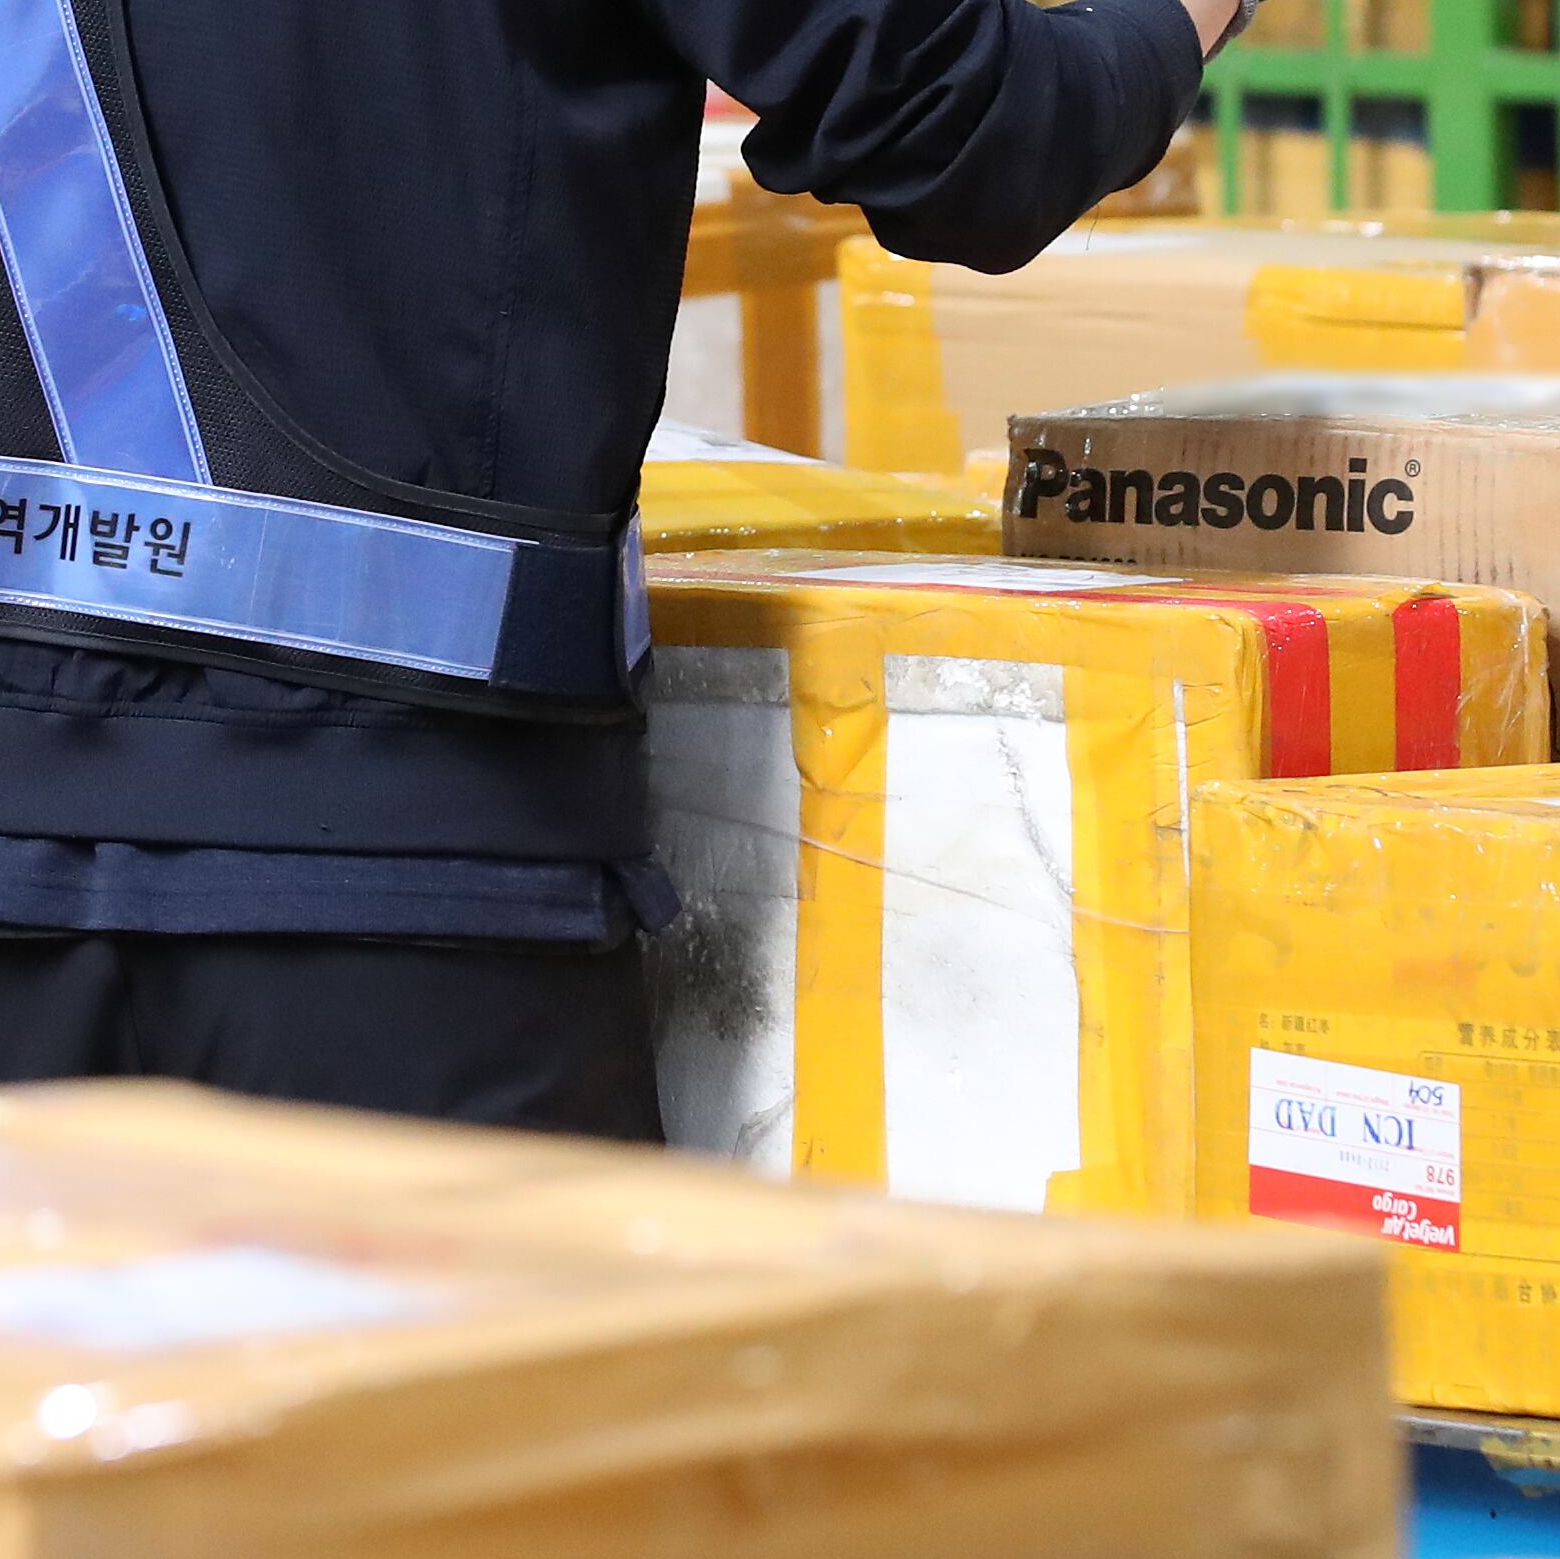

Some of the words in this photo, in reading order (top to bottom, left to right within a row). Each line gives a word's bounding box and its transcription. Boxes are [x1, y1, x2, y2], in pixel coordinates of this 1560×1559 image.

[1273, 1097, 1337, 1138] DAD
[1362, 1112, 1416, 1151] ICN
[1425, 1165, 1456, 1186] 978
[1372, 1192, 1417, 1219] Cargo
